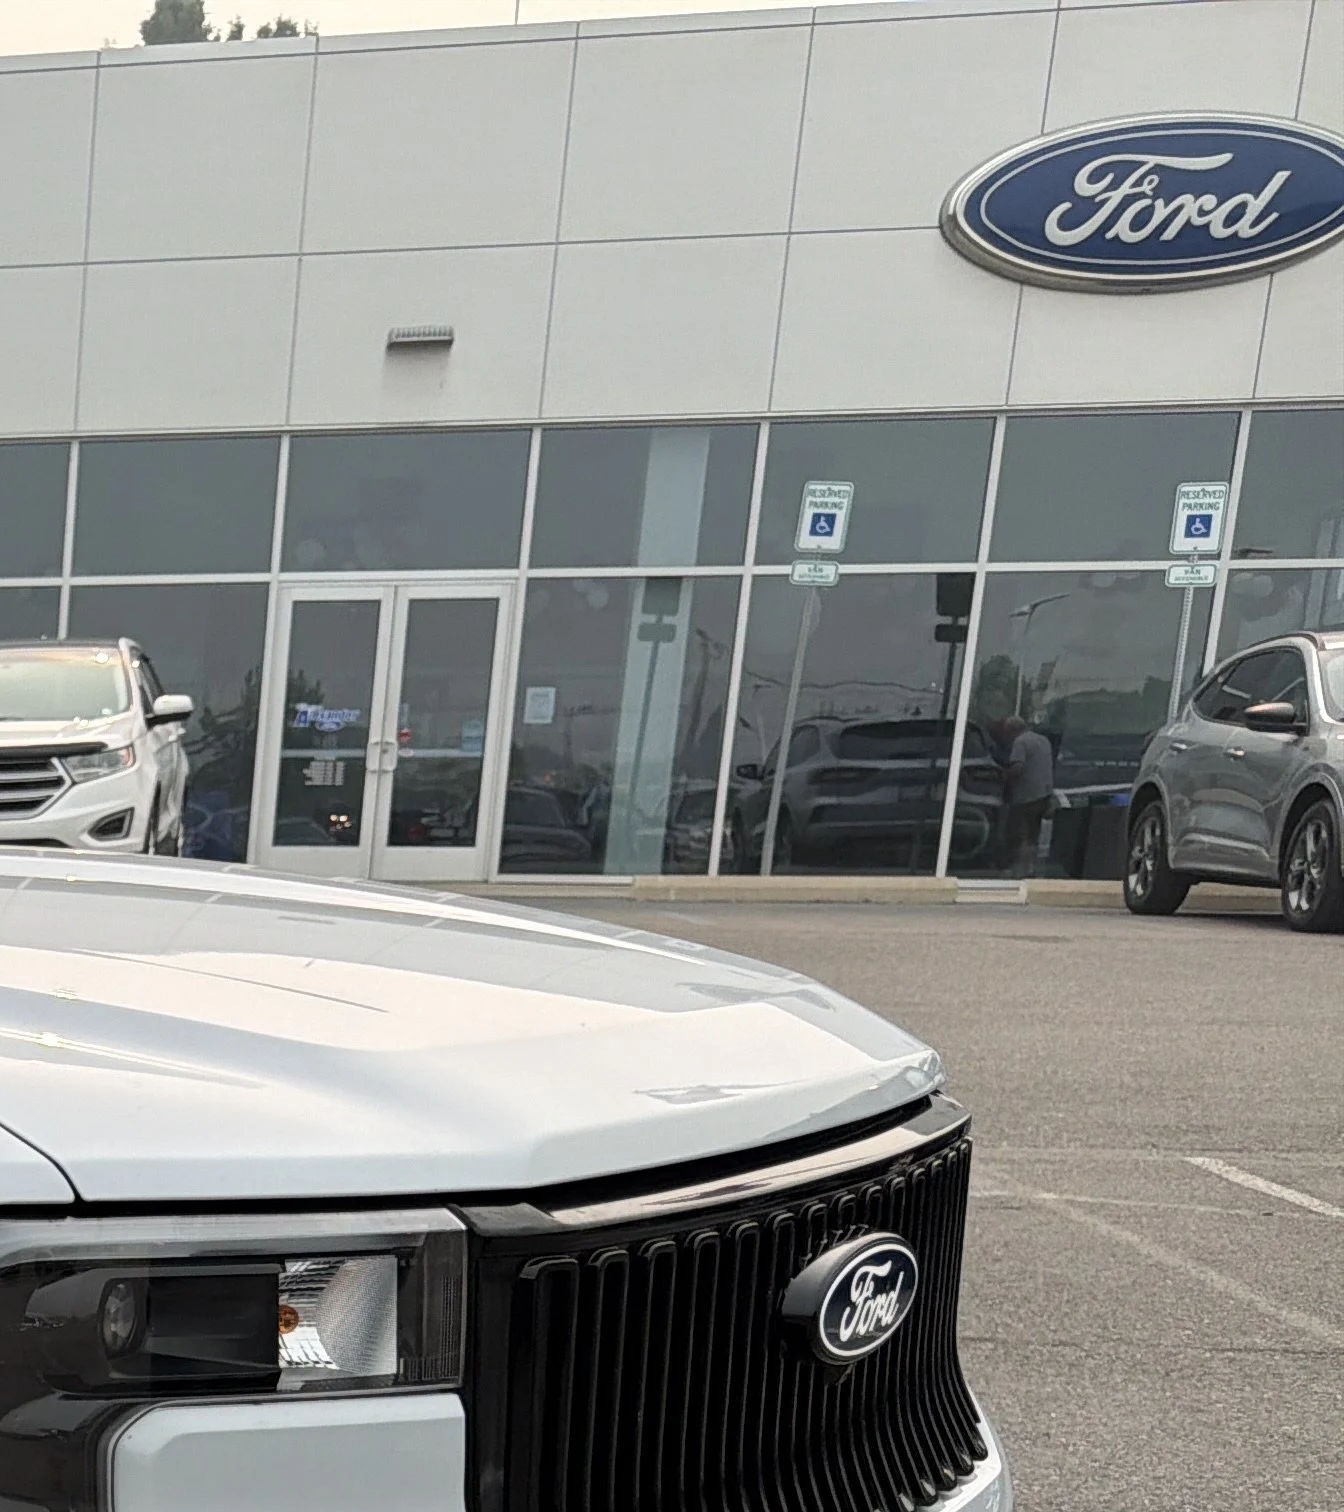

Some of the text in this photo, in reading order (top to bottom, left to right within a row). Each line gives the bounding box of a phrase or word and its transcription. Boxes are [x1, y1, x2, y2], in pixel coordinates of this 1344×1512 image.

[1044, 152, 1292, 246] Ford
[1180, 489, 1225, 500] RESERVED
[808, 501, 845, 511] PARKING
[1181, 502, 1221, 512] PARKING
[840, 1260, 905, 1342] Ford
